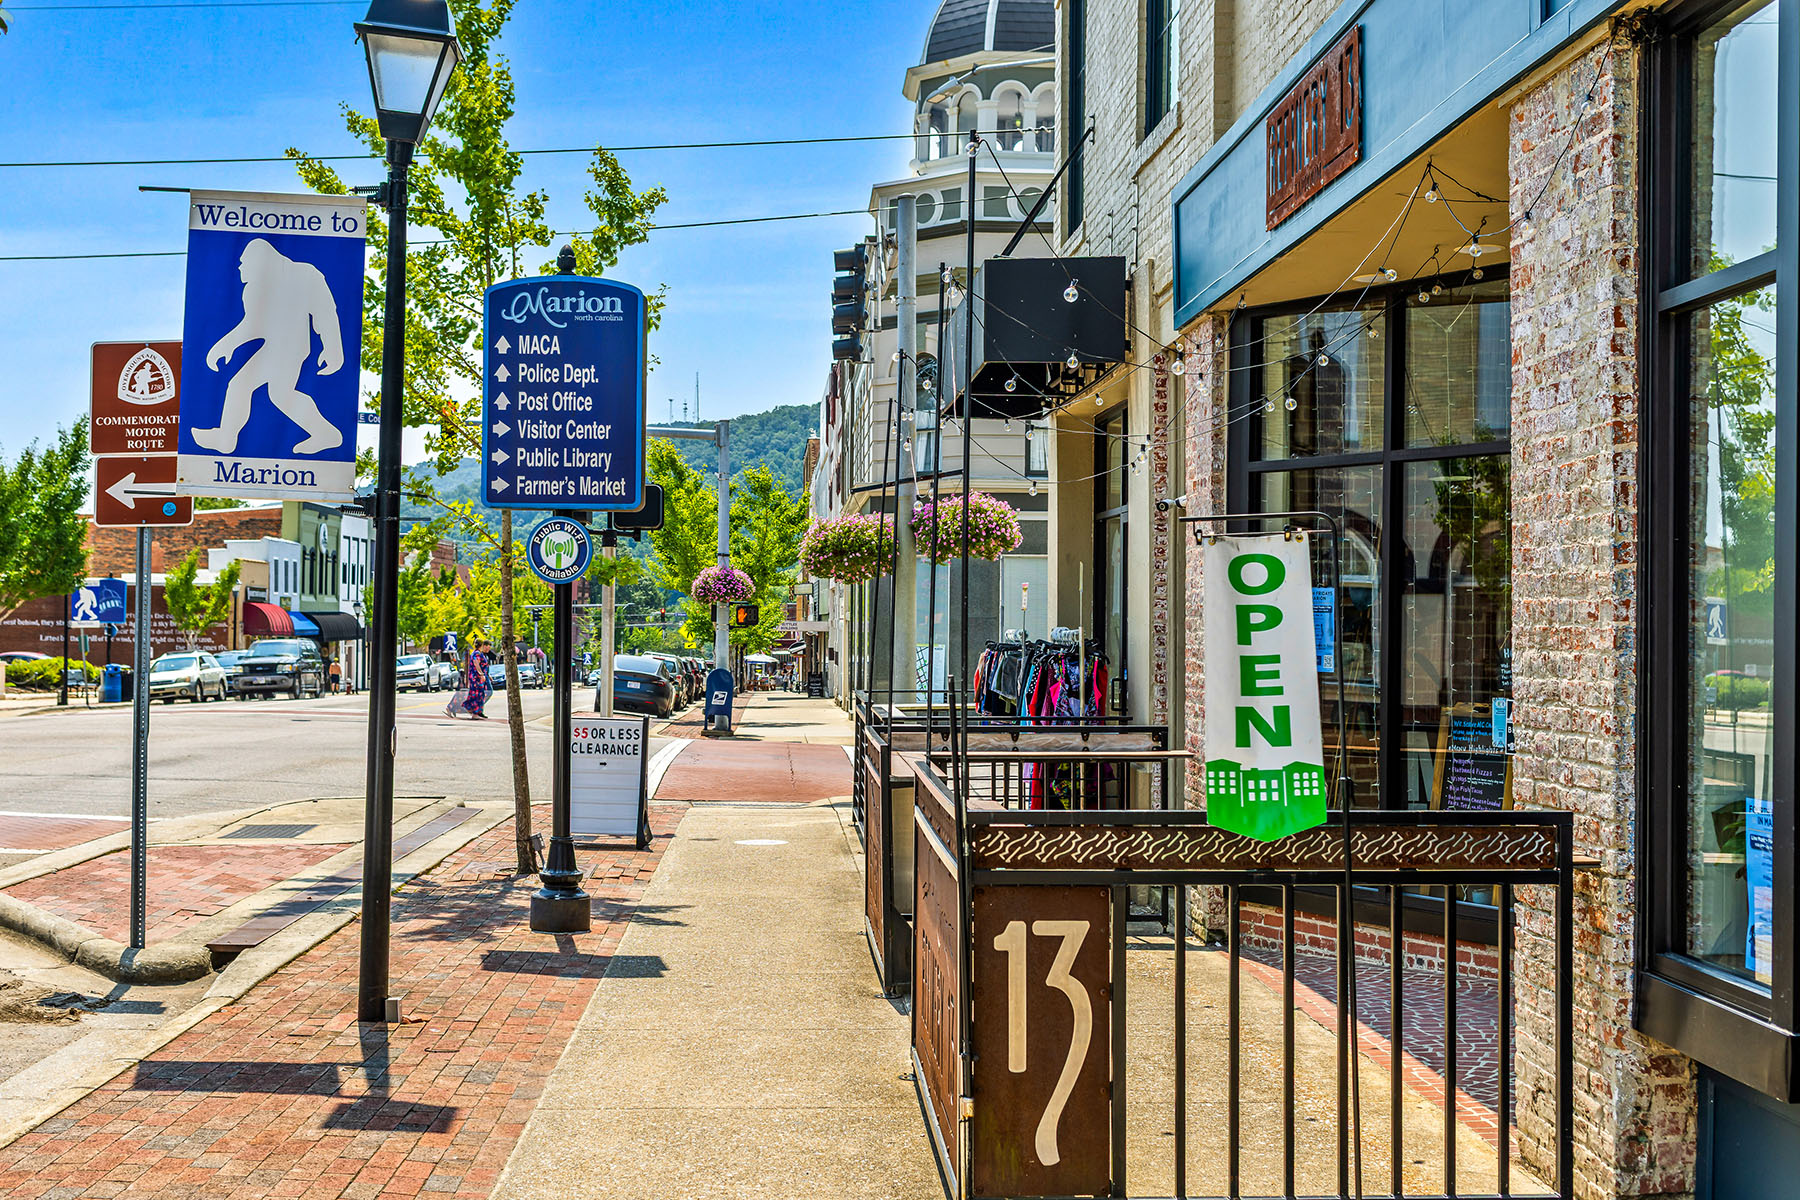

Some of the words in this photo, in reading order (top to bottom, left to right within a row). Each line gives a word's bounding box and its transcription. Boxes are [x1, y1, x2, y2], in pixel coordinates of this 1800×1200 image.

[1268, 68, 1329, 197] REFINERY
[1338, 43, 1355, 135] 13
[198, 204, 322, 232] Welcome
[331, 210, 358, 234] to
[501, 286, 624, 329] Marion
[518, 334, 561, 355] MACA
[518, 363, 560, 383] Police
[563, 363, 599, 388] Dept.
[518, 391, 548, 411] Post
[552, 391, 593, 411] Office
[95, 415, 180, 426] COMMEMORATI
[517, 419, 562, 439] Visitor
[565, 419, 611, 440] Center
[125, 427, 166, 437] MOTOR
[127, 439, 165, 449] ROUTE
[516, 447, 559, 467] Public
[563, 447, 612, 473] Library
[213, 461, 317, 487] Marion
[516, 475, 576, 496] Farmer's
[579, 475, 626, 496] Market
[533, 522, 561, 545] Public
[539, 564, 579, 578] Available
[1227, 553, 1292, 748] OPEN
[573, 727, 589, 739] $5
[591, 727, 606, 739] OR
[609, 728, 640, 740] LESS
[571, 742, 639, 756] CLEARANCE
[993, 920, 1093, 1167] 13
